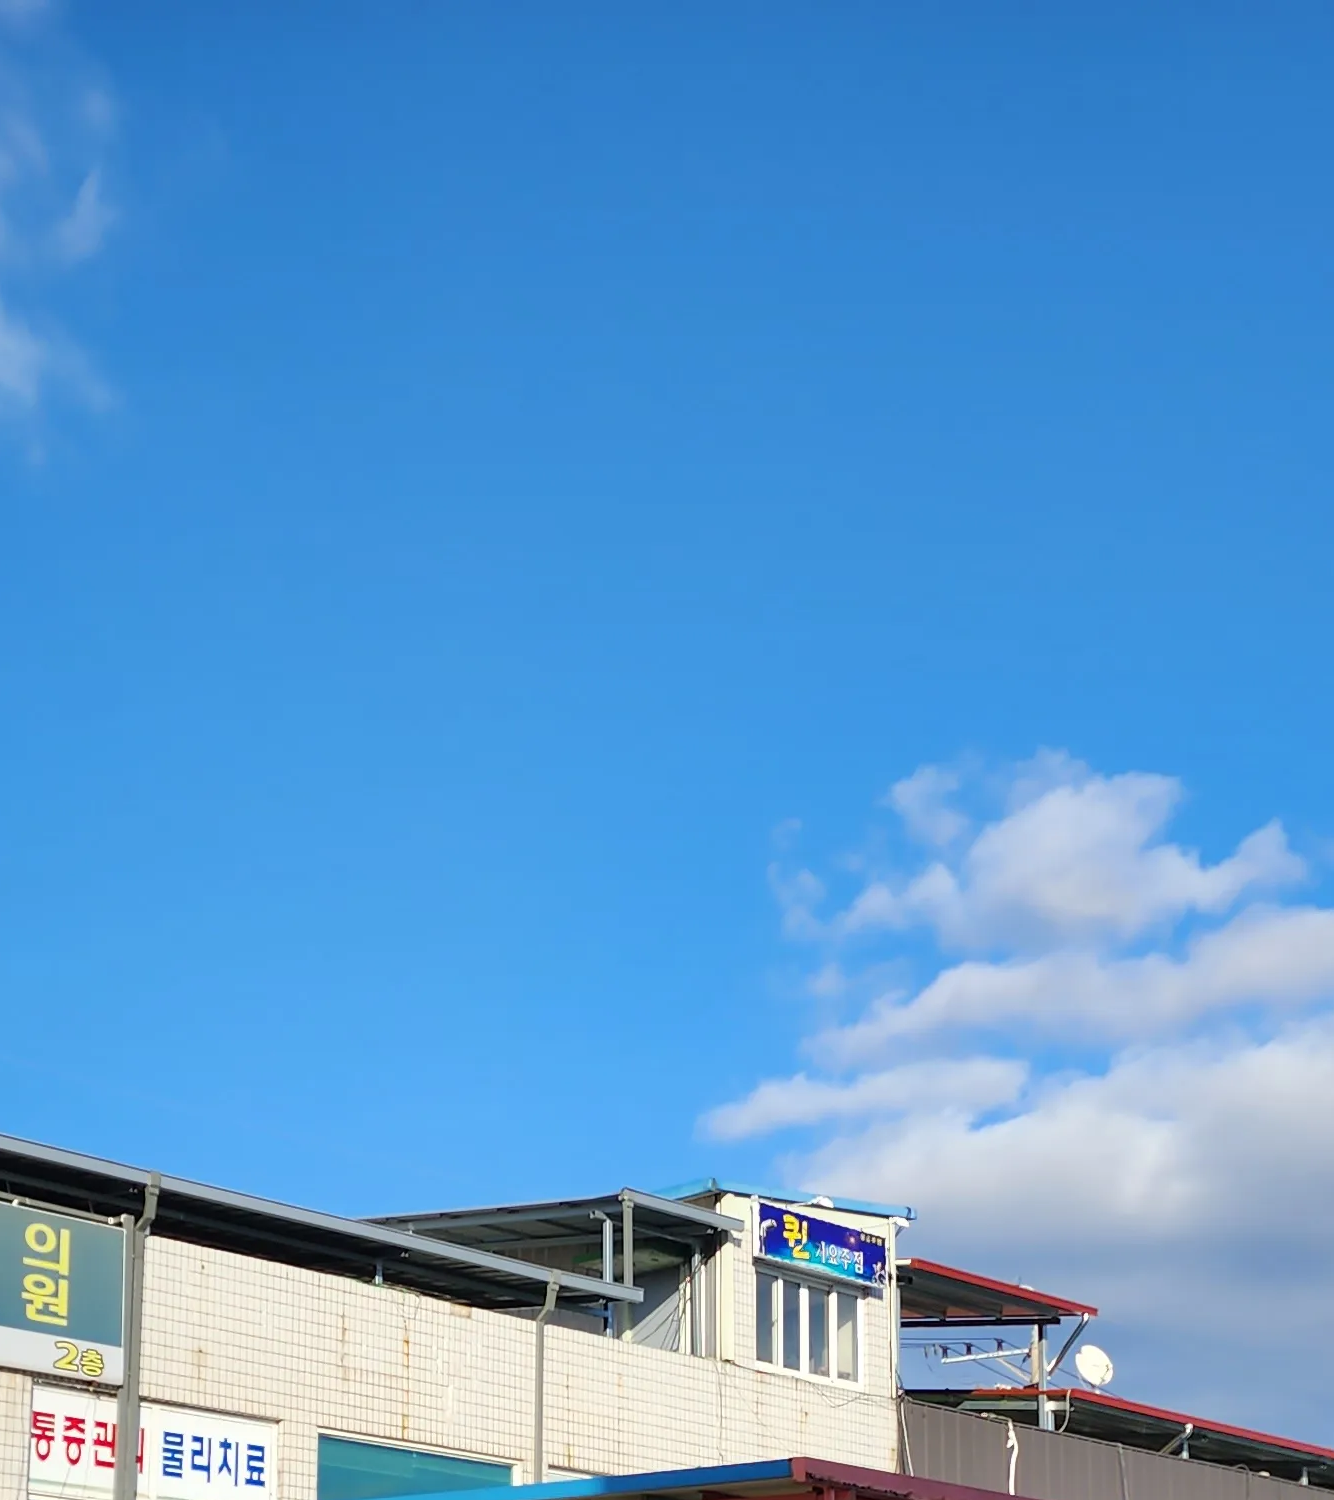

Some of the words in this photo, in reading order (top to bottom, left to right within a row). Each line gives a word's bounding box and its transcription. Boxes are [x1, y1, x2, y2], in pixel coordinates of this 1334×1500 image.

[782, 1213, 811, 1260] 퀸
[20, 1220, 71, 1328] 의원
[53, 1339, 105, 1378] 2층
[161, 1430, 269, 1493] 물리치료
